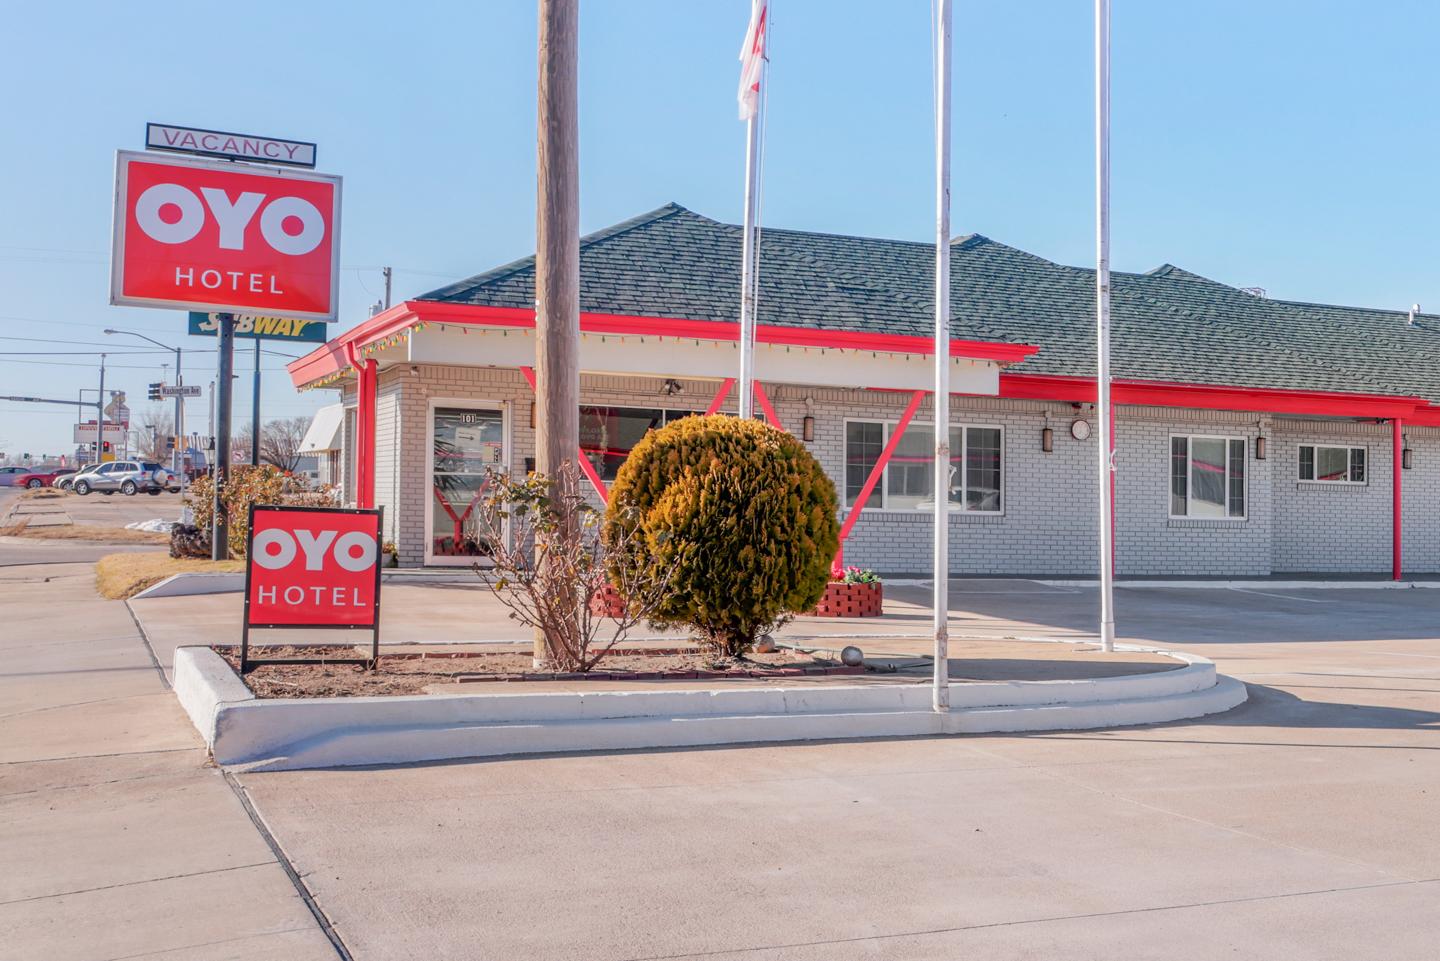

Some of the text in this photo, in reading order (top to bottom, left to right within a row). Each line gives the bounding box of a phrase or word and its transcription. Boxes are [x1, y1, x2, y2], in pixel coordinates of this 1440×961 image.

[162, 128, 301, 160] VACANCY
[135, 183, 325, 256] OYO
[175, 267, 284, 295] HOTEL
[198, 312, 309, 337] SBWAY
[462, 415, 475, 423] 101
[252, 528, 377, 572] OYO
[258, 585, 367, 607] HOTEL
